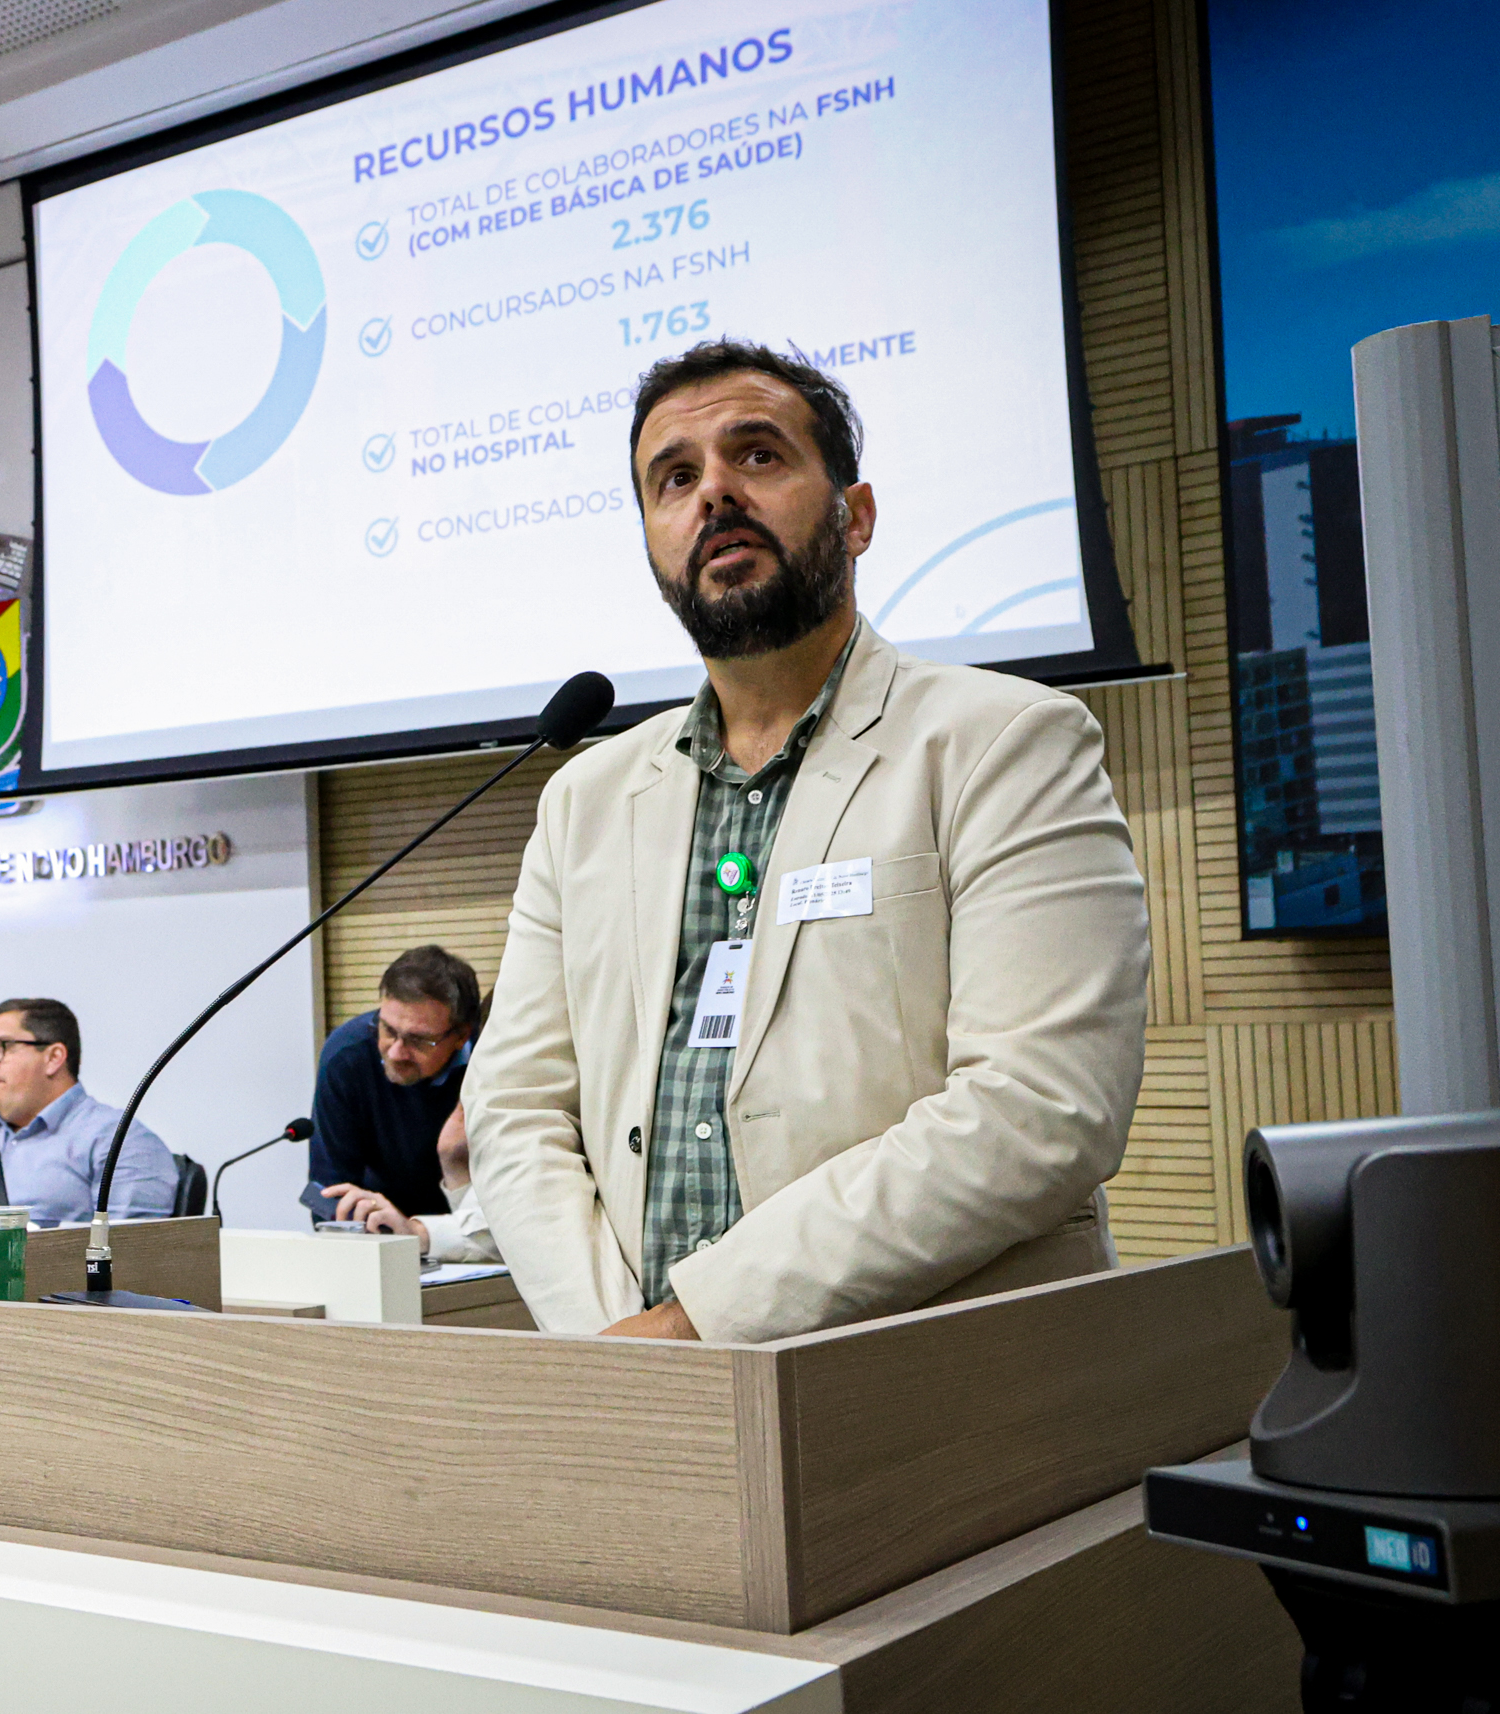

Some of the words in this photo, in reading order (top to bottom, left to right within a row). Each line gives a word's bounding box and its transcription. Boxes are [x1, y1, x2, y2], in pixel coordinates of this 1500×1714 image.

[354, 97, 555, 183] RECURSOS
[568, 27, 793, 122] HUMANOS
[407, 191, 479, 225] TOTAL
[485, 179, 518, 205] DE
[525, 113, 760, 194] COLABORADORES
[768, 101, 808, 129] NA
[816, 75, 895, 117] FSNH
[408, 220, 470, 258] (COM
[478, 201, 542, 235] REDE
[551, 175, 646, 216] BÁSICA
[654, 162, 689, 190] DE
[698, 132, 802, 178] SAÚDE)
[611, 198, 710, 250] 2.376
[411, 273, 615, 340] CONCURSADOS
[624, 262, 664, 291] NA
[672, 240, 750, 280] FSNH
[618, 300, 710, 347] 1.763
[409, 418, 482, 449] TOTAL
[488, 409, 521, 435] DE
[805, 330, 916, 368] MENTE
[411, 453, 446, 477] NO
[453, 429, 575, 469] HOSPITAL
[417, 487, 624, 543] CONCURSADOS
[87, 831, 231, 878] HAMBURGO
